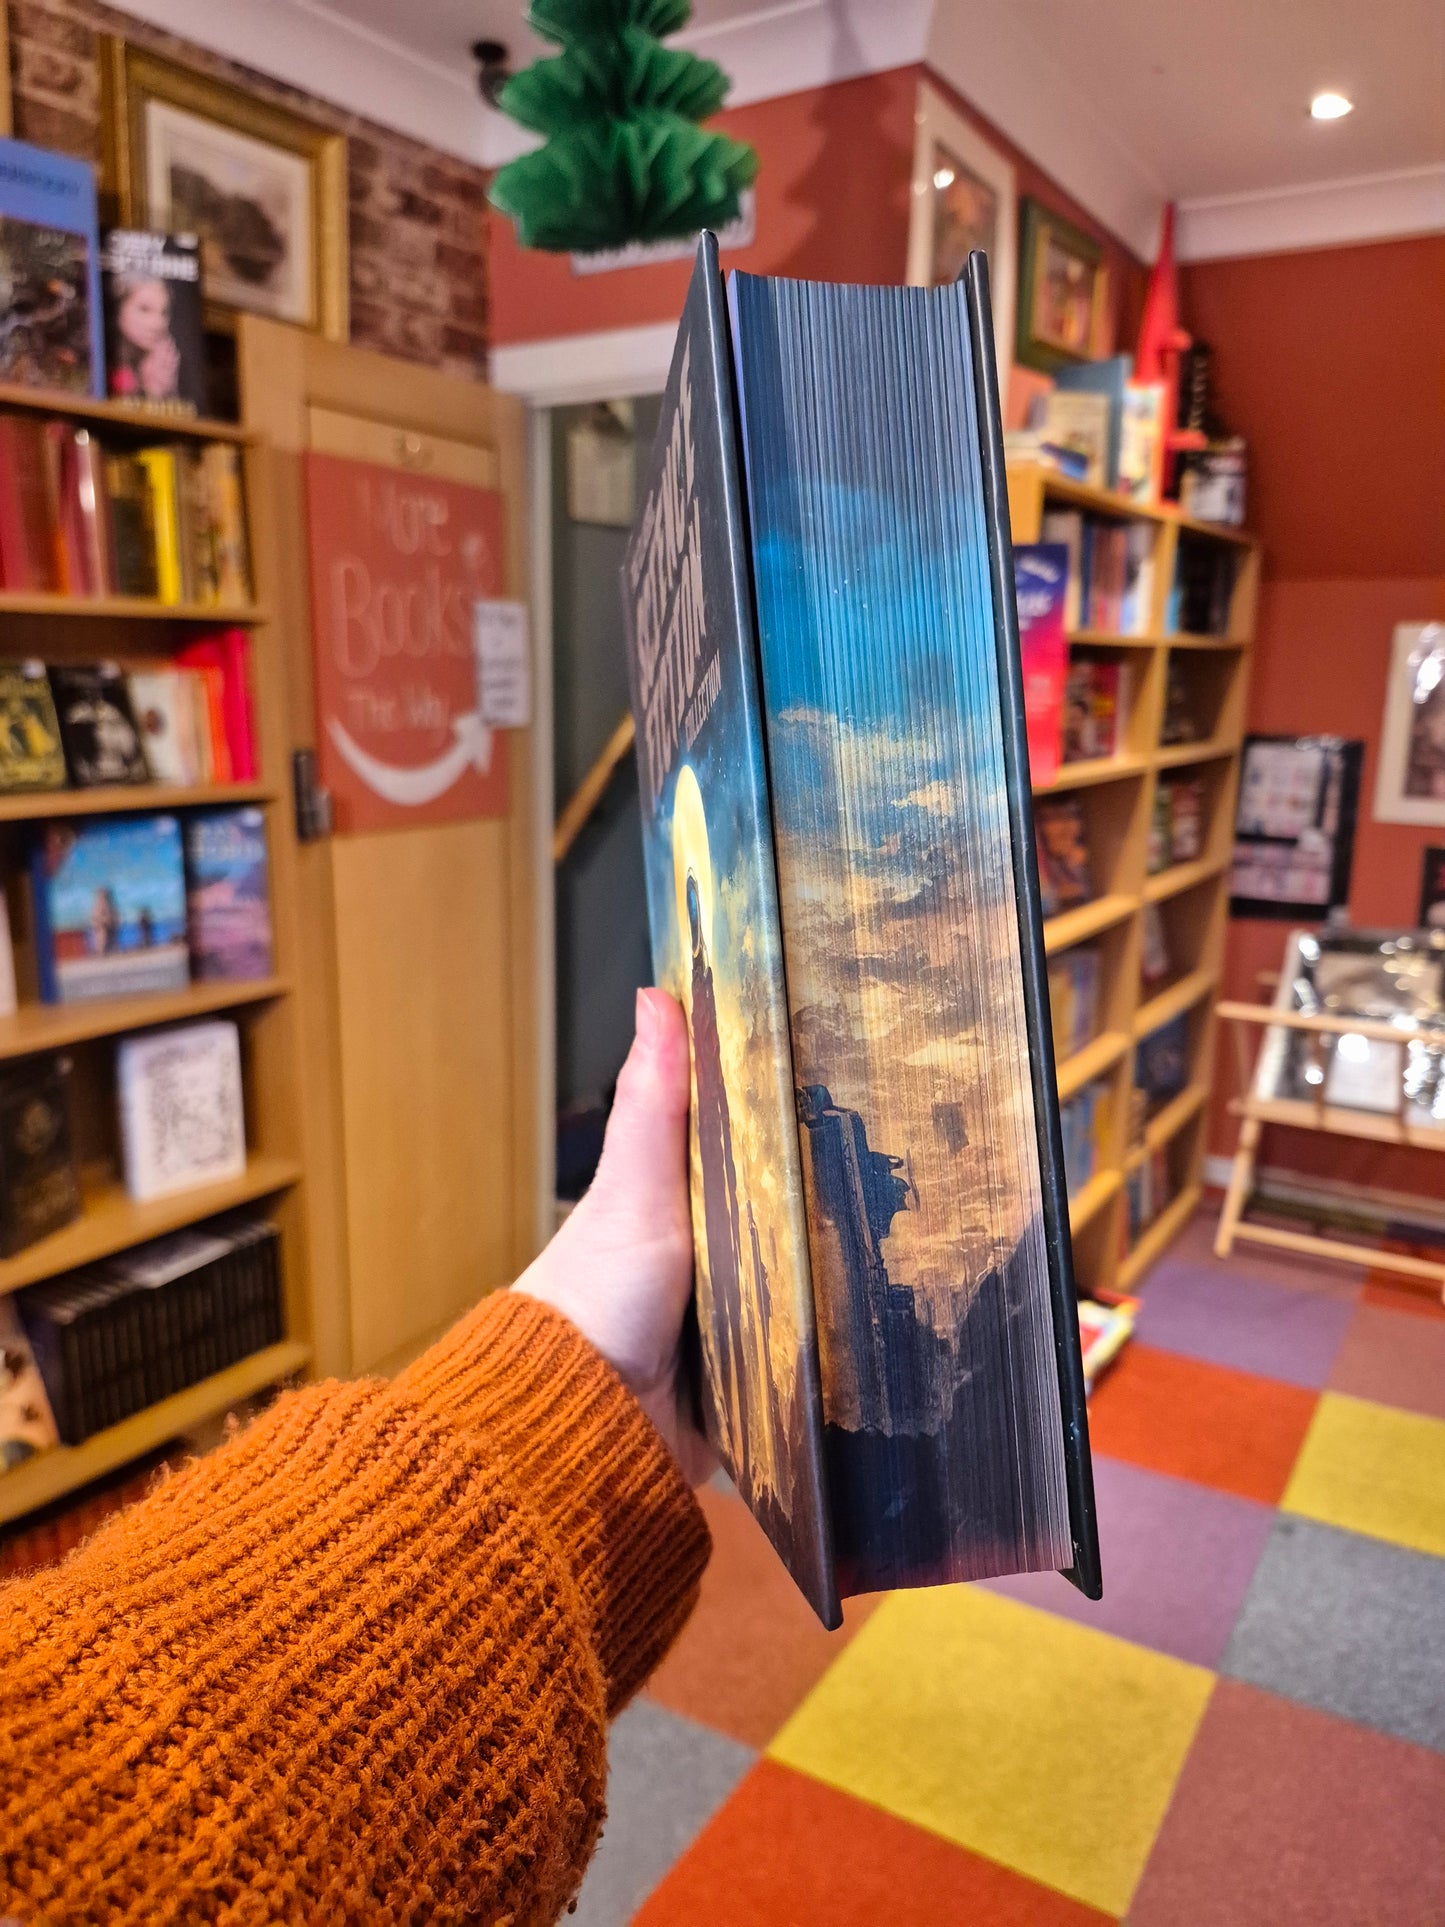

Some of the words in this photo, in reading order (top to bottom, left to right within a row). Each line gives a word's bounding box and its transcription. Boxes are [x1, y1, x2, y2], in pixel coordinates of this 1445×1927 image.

[330, 553, 474, 679] Books
[637, 332, 695, 710] SCIENCE
[646, 496, 706, 815] FICTION
[685, 648, 722, 752] COLLECTION
